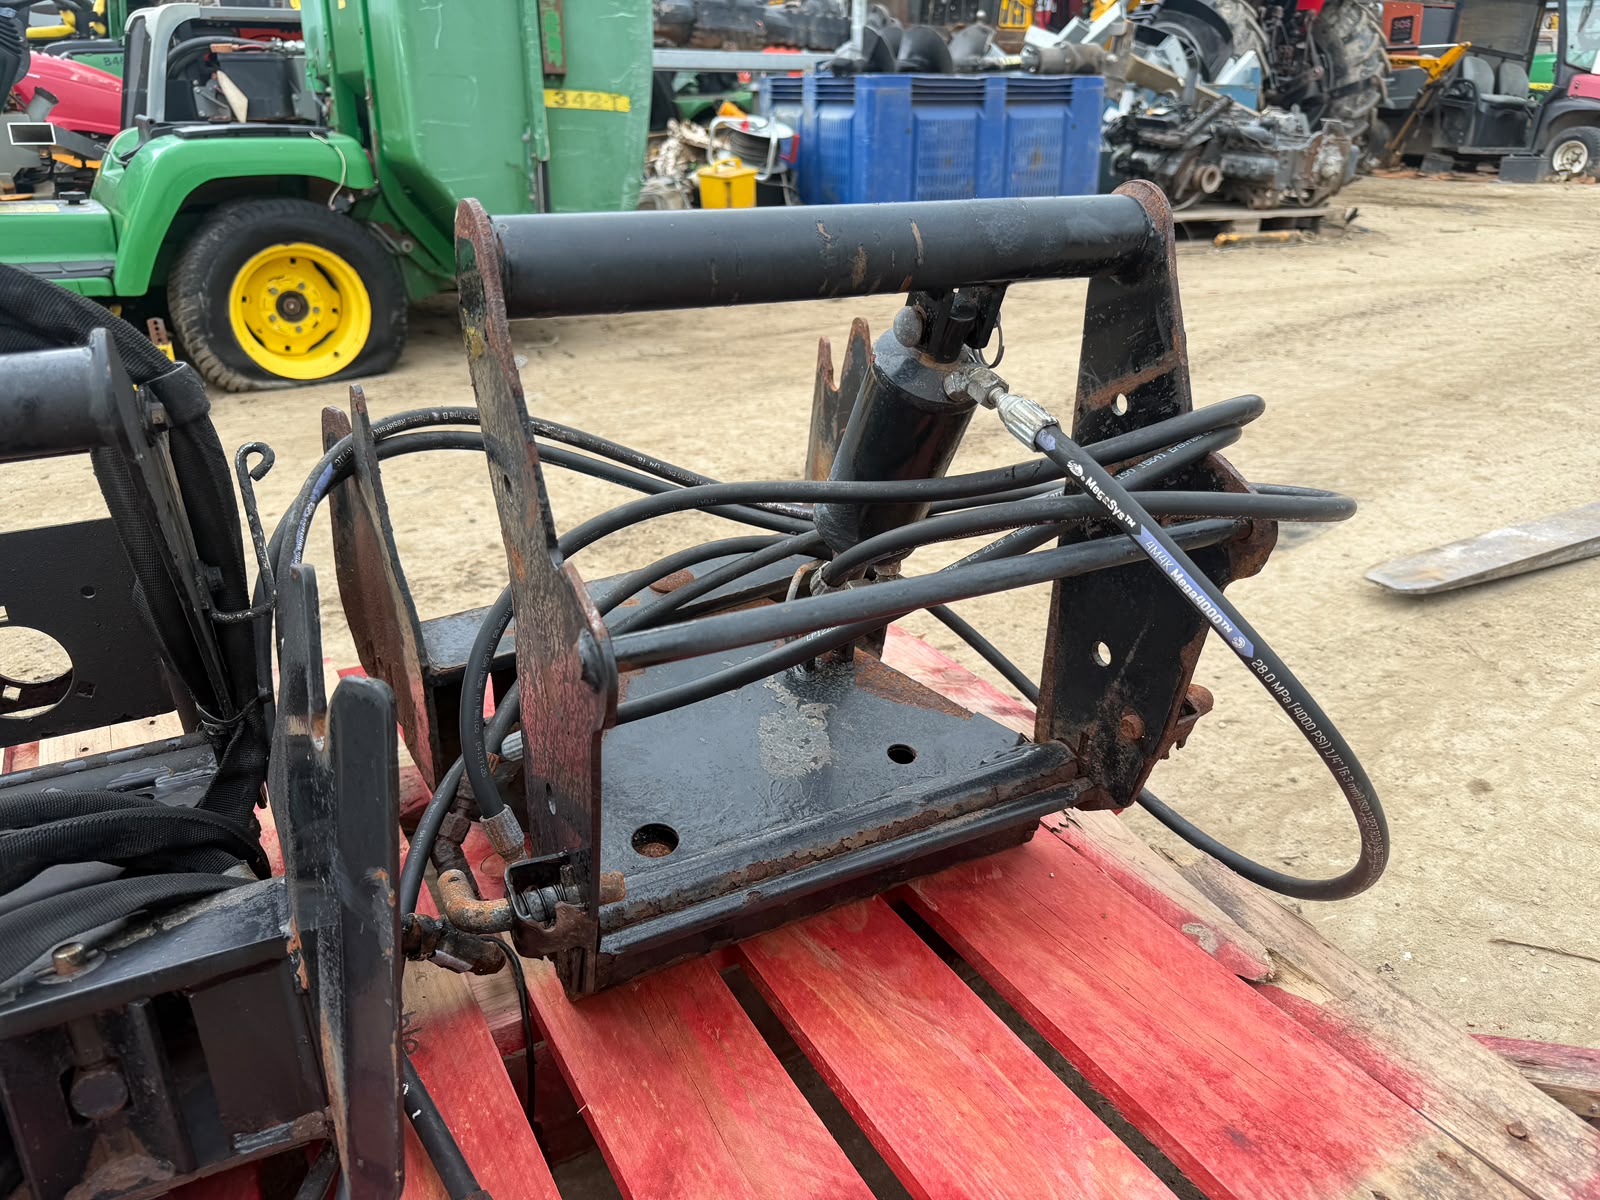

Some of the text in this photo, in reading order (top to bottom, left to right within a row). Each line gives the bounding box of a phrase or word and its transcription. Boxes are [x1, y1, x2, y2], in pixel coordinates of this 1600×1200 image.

[1145, 541, 1176, 571] 4M4K
[1251, 658, 1277, 684] 28.0
[1271, 680, 1293, 704] MPa
[1290, 702, 1316, 732] (4000
[1312, 729, 1333, 751] PSI)
